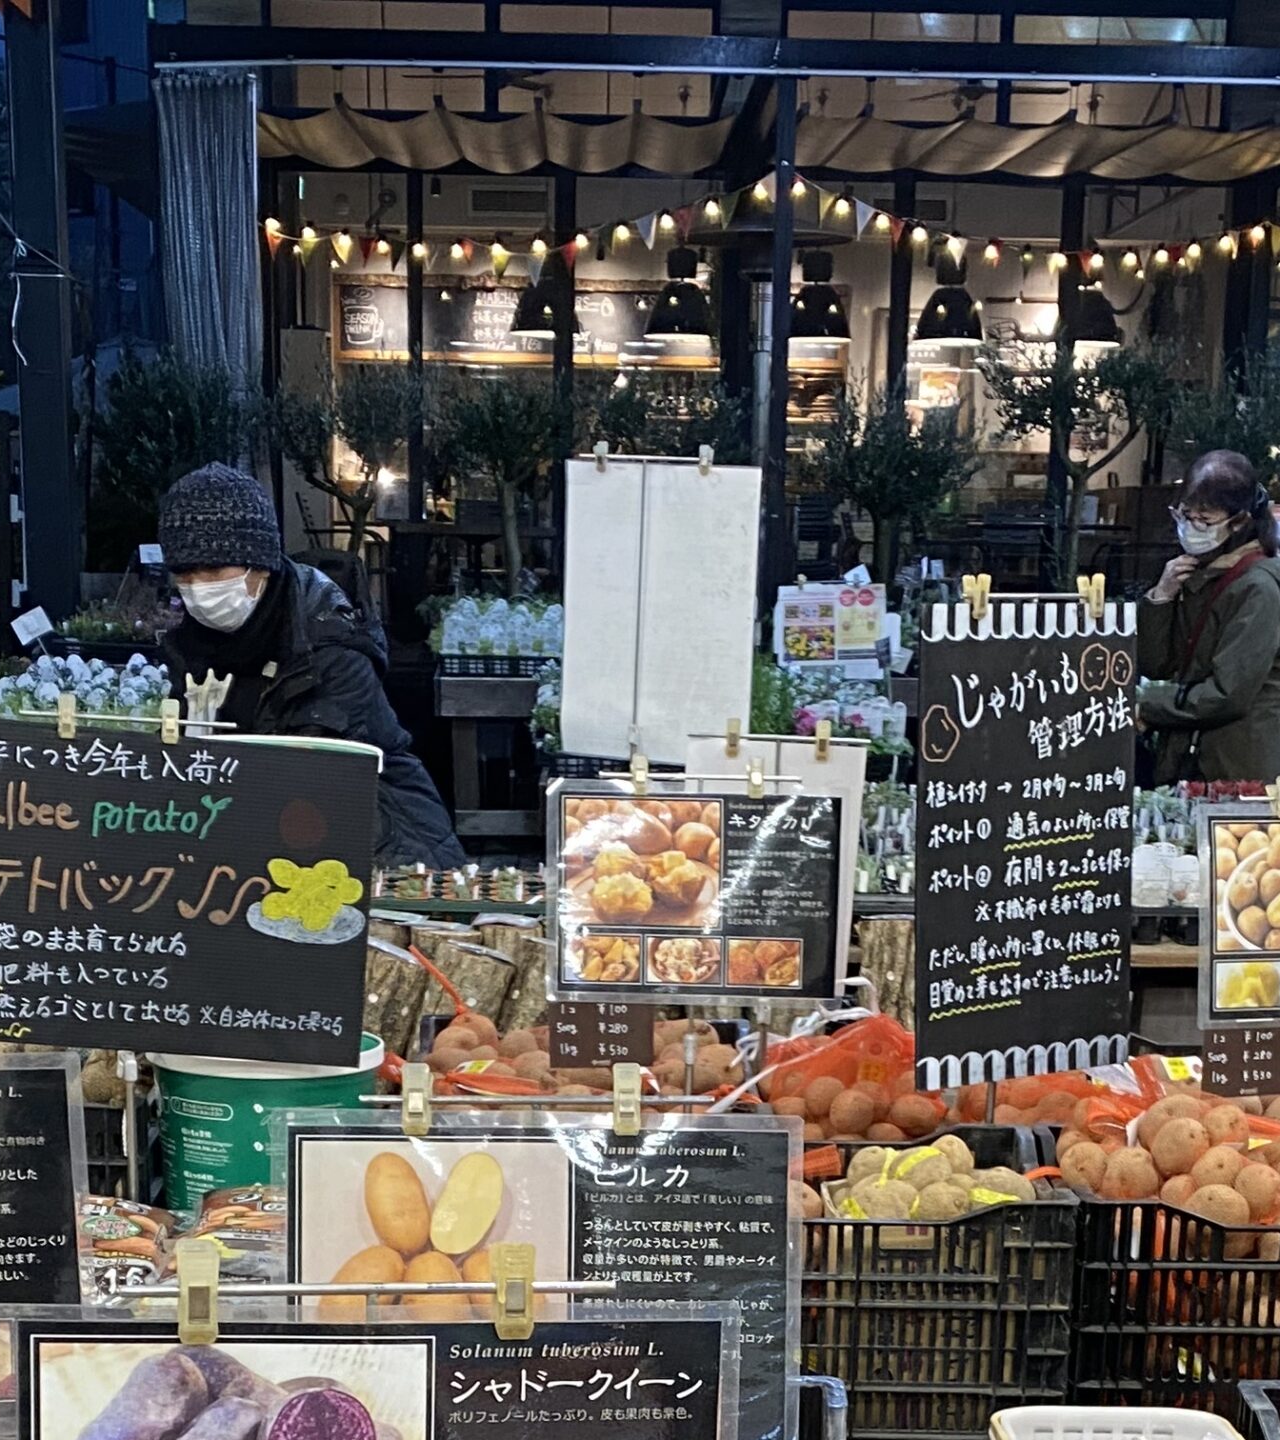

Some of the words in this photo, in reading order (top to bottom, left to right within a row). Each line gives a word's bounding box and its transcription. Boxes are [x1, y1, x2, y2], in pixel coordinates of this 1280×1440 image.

[952, 652, 1079, 729] じゃがいも
[1028, 688, 1134, 760] 管理方法
[728, 813, 812, 831] キタカリ
[449, 1344, 533, 1359] Solanum
[541, 1342, 640, 1358] tuberosum
[450, 1367, 703, 1403] シャドークイーン
